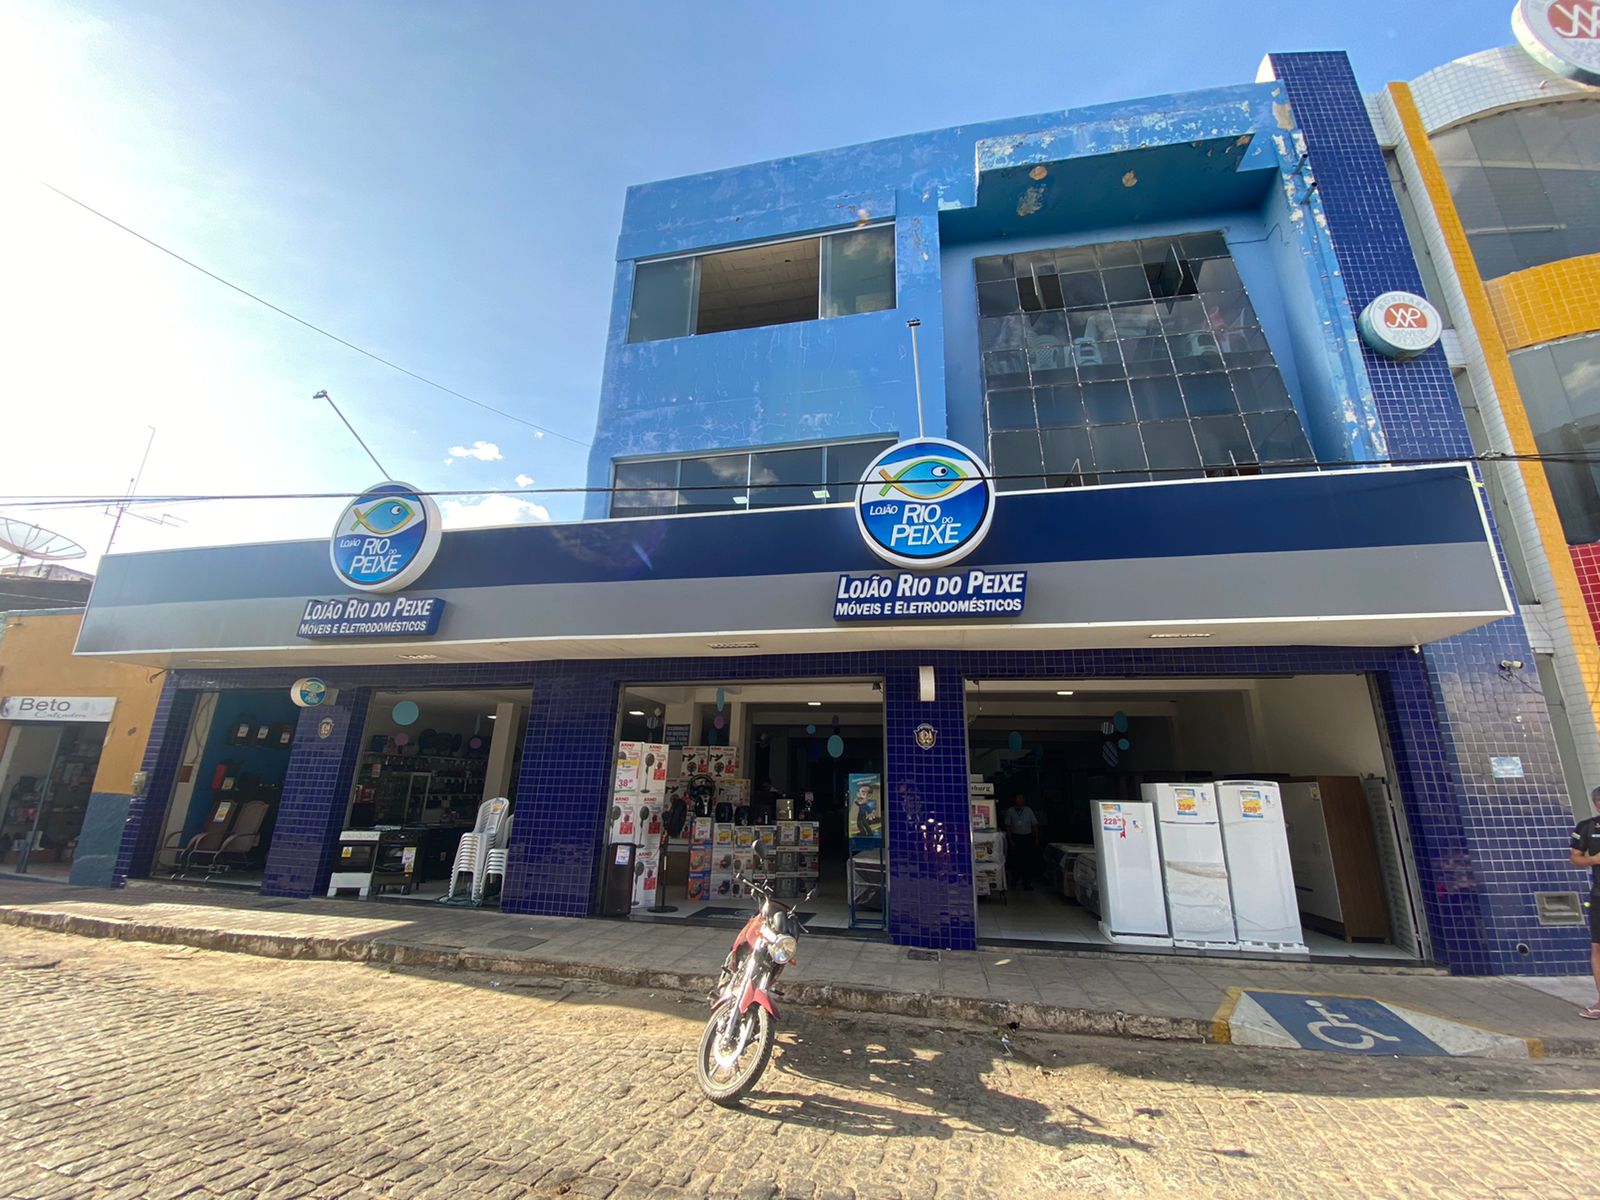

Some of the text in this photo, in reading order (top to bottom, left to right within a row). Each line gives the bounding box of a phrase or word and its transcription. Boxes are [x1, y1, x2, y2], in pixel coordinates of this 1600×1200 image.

[869, 503, 942, 524] LOJÃO RIO
[941, 516, 954, 524] DO
[890, 522, 962, 547] PEIXE
[339, 538, 391, 556] LOJÃO RIO
[348, 554, 402, 575] PEIXE
[837, 572, 1025, 599] LOJÃO RIO DO PEIXE
[303, 597, 434, 621] LOJÃO RIO DO PEIXE
[835, 598, 1022, 616] MÓVEIS E ELETRODOMÉSTICOS
[299, 619, 427, 635] MÓVEIS E ELETRODOMÉSTICOS
[19, 697, 71, 712] Beto
